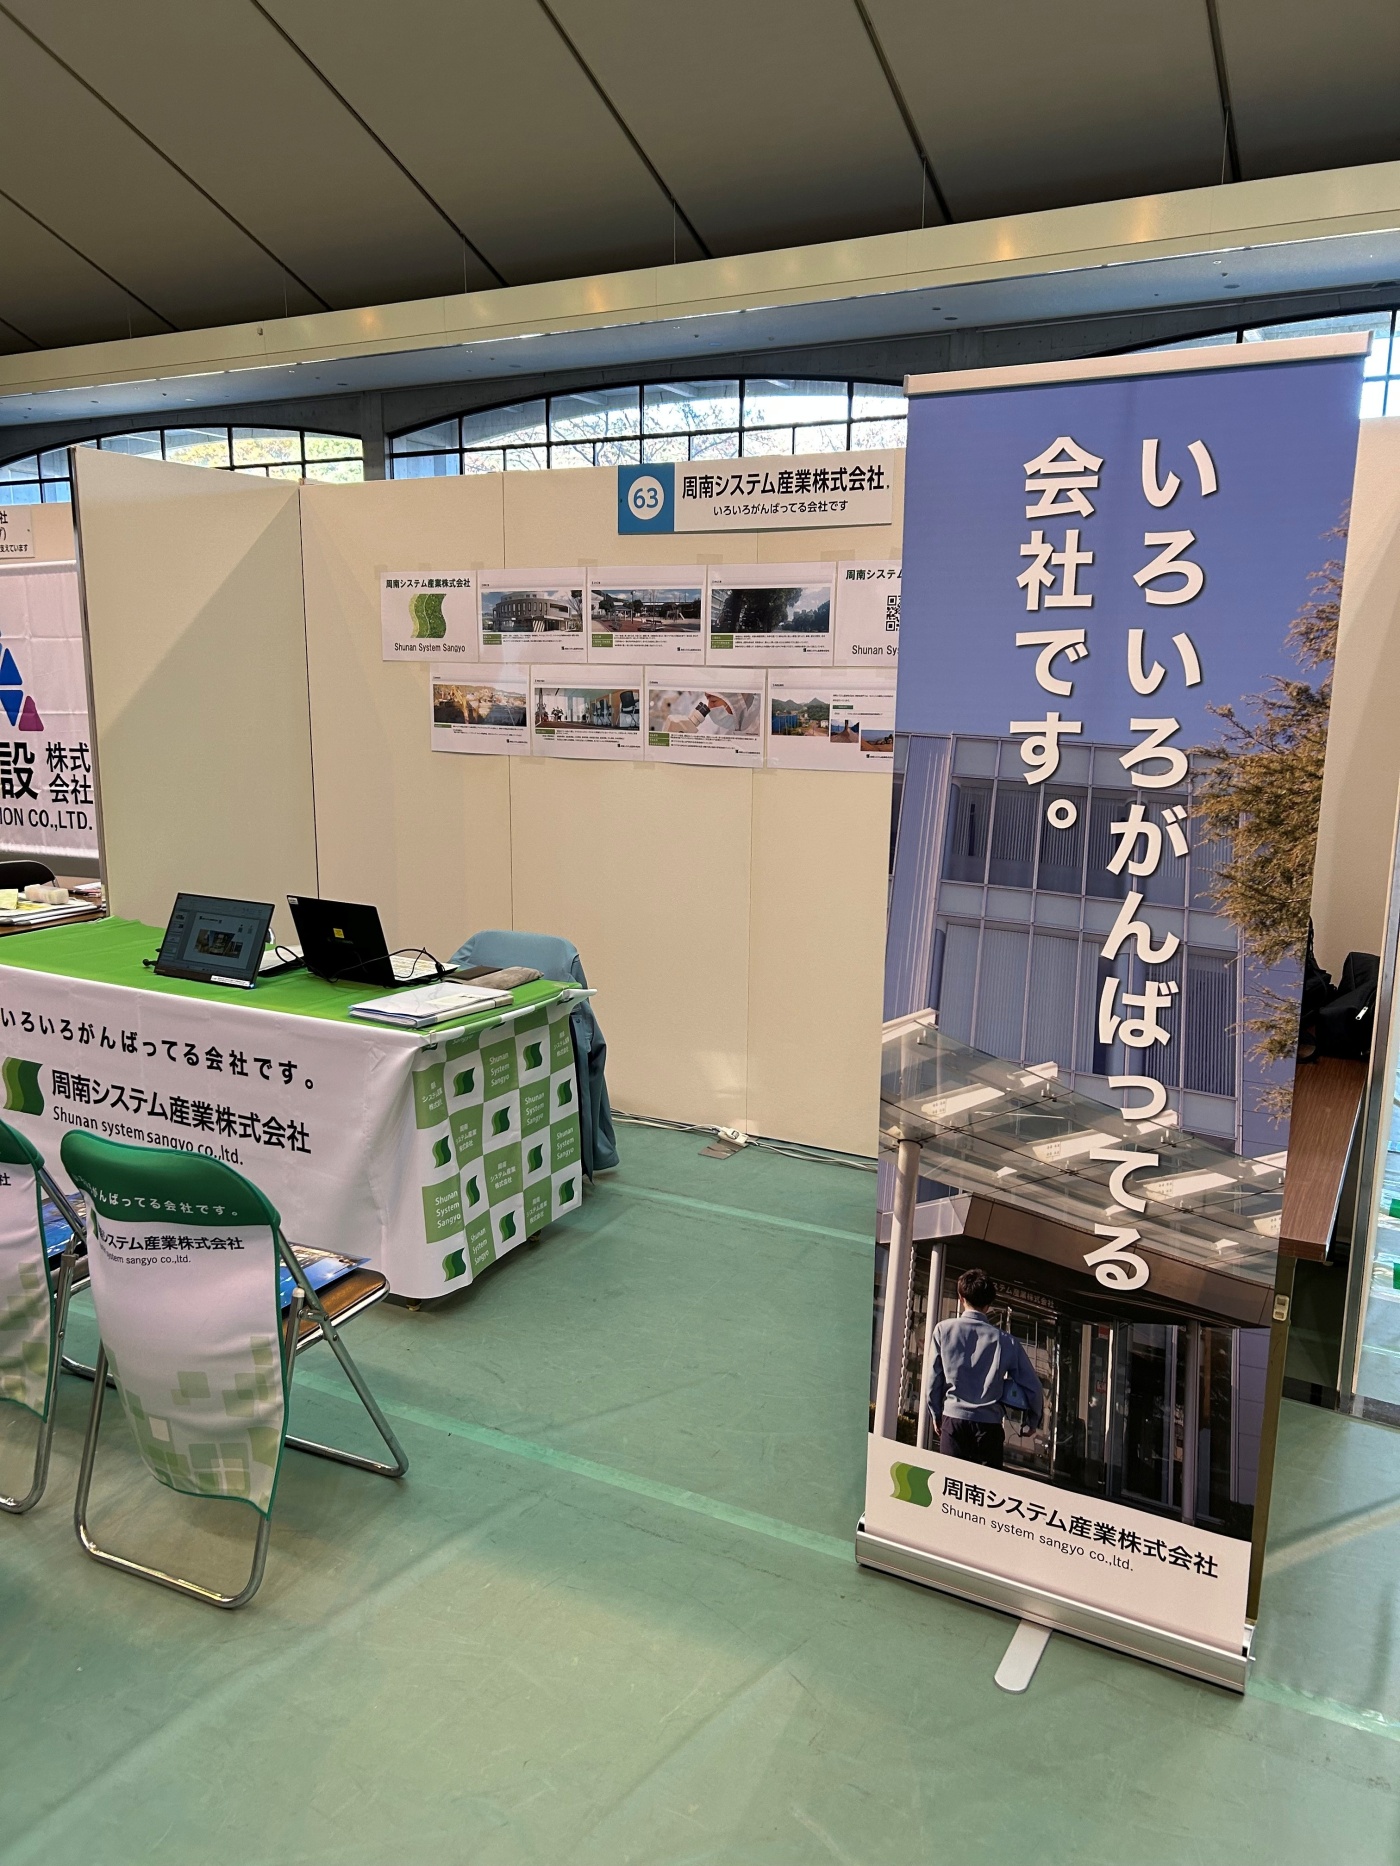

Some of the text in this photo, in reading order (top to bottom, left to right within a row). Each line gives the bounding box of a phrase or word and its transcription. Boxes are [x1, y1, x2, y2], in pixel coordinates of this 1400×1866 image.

[633, 487, 659, 510] 63
[682, 465, 886, 500] 周南システム産業株式会社
[713, 500, 849, 517] いろいろがんばってる会社です
[386, 578, 471, 589] 周南システム産業株式会社
[394, 642, 466, 653] Shunan System Sangyo
[1010, 436, 1104, 830] 会社です。
[852, 644, 884, 655] Shunan
[0, 741, 39, 801] 設
[46, 741, 91, 773] 株式
[49, 773, 93, 805] 会社
[28, 808, 93, 831] CO.,LTD.
[1083, 438, 1218, 1292] いろいろがんばってる
[0, 1007, 314, 1090] いろいろがんばってる会社です。
[52, 1069, 311, 1155] 周南システム産業株式会社
[53, 1106, 98, 1130] Shunan
[101, 1120, 145, 1141] system
[435, 1190, 458, 1206] Shunan
[436, 1202, 460, 1217] System
[437, 1213, 461, 1229] Sangyo
[125, 1254, 158, 1266] sangyo
[160, 1254, 192, 1264] co.,ltd.
[941, 1502, 1134, 1571] Shunan system sangyo co.,ltd.
[942, 1476, 1219, 1579] 周南システム産業株式会社
